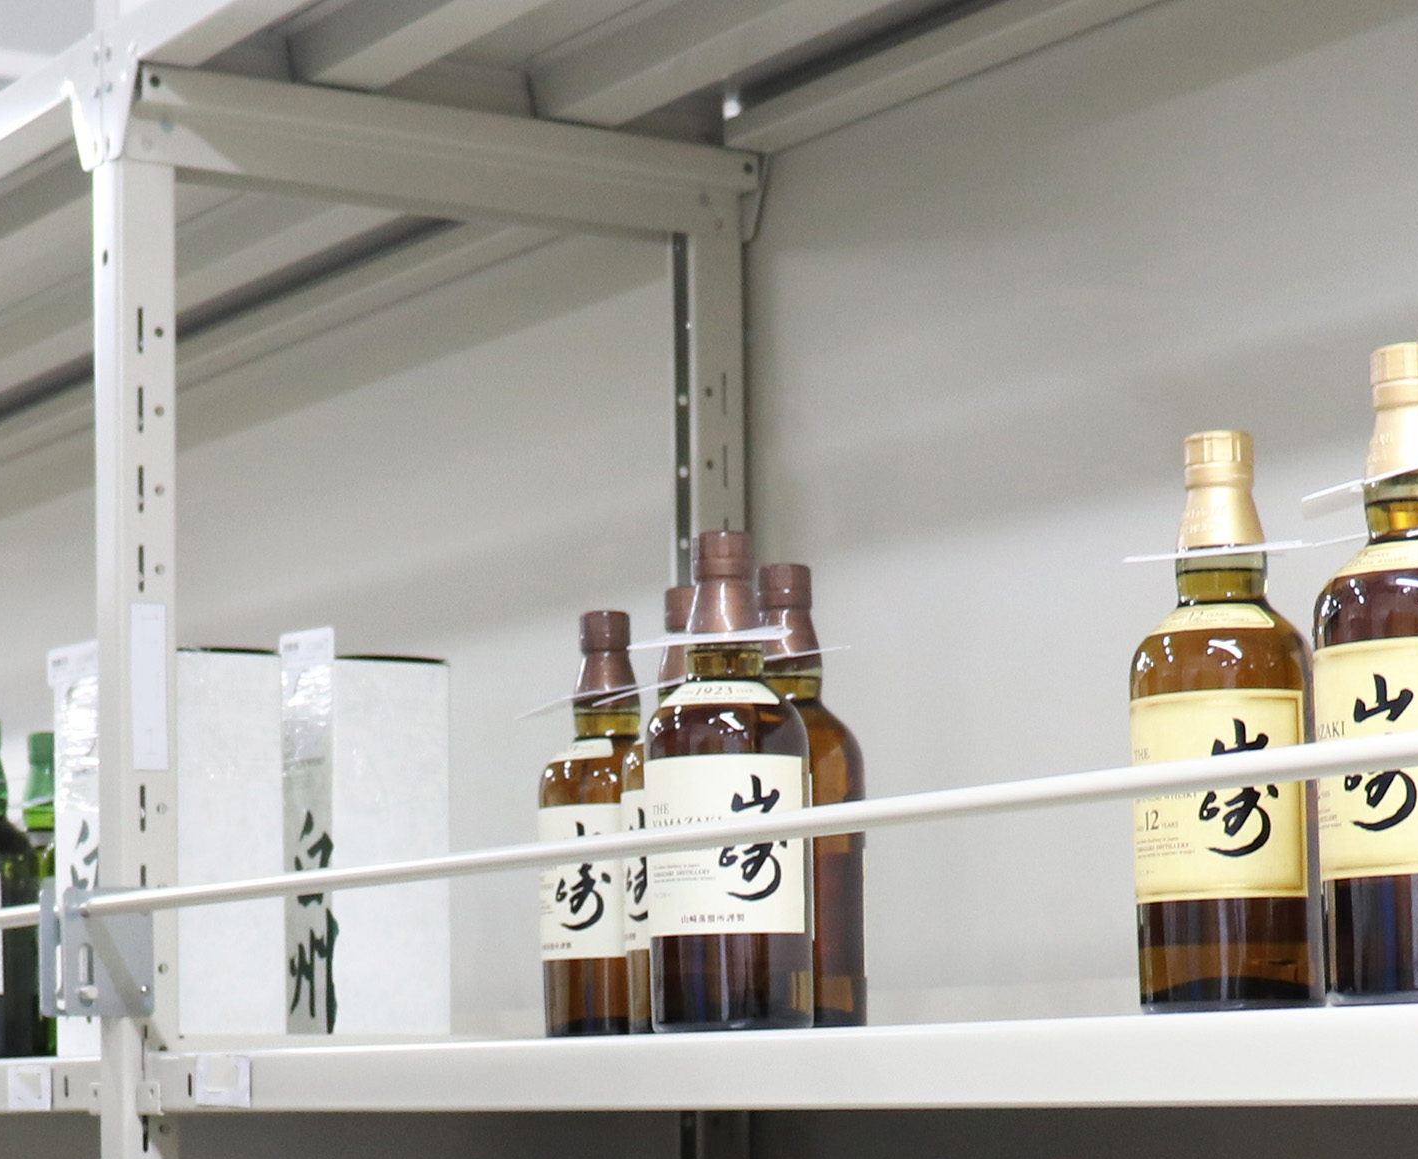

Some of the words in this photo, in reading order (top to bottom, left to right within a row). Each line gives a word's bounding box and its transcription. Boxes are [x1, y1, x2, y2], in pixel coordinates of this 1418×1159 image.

[1318, 720, 1346, 740] ZAKI
[719, 773, 787, 901] 山崎
[1145, 808, 1160, 832] 12
[289, 810, 339, 1034] 白州
[555, 821, 612, 932] 崎
